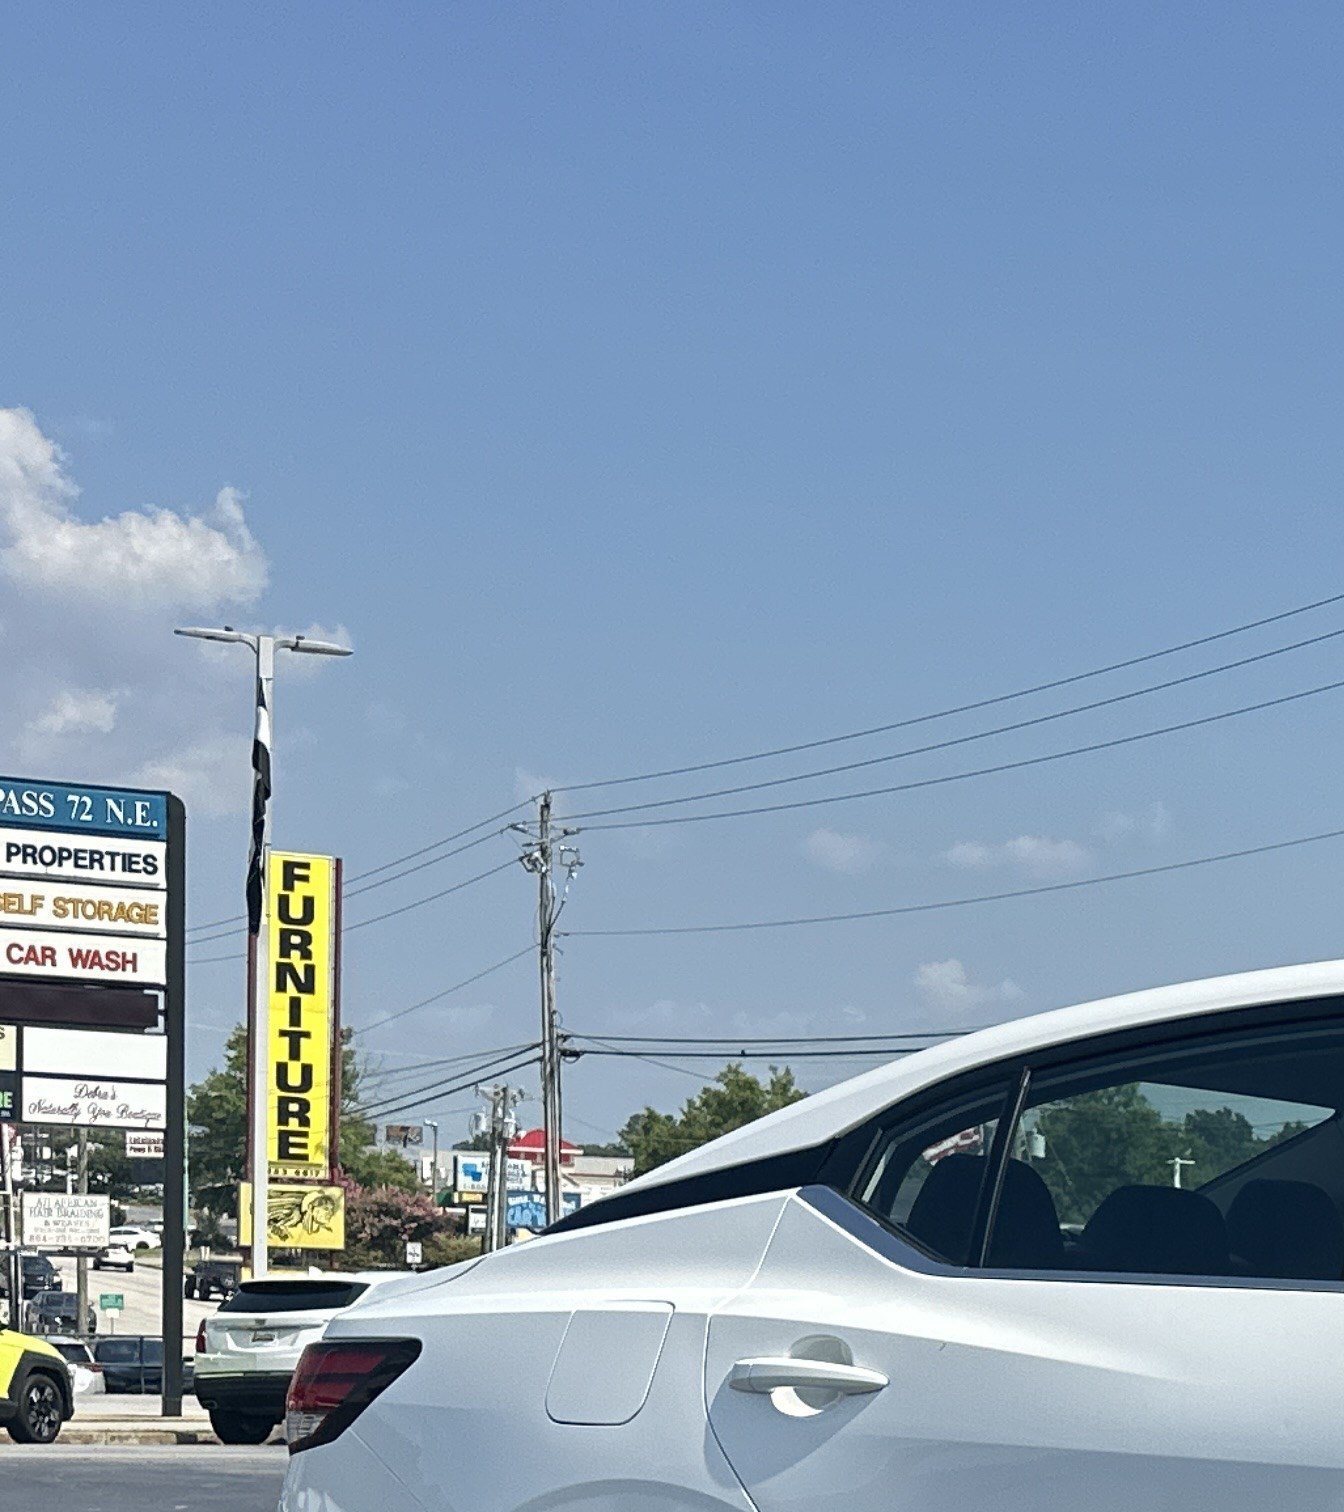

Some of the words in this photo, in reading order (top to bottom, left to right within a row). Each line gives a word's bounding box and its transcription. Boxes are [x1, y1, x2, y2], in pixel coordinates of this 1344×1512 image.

[67, 794, 93, 822] 72
[106, 798, 158, 827] N.E.
[6, 842, 159, 875] PROPERTIES
[0, 892, 45, 915] ELF
[53, 896, 159, 925] STORAGE
[6, 943, 57, 967] CAR
[68, 947, 138, 973] WASH
[275, 860, 315, 1161] FURNITURE
